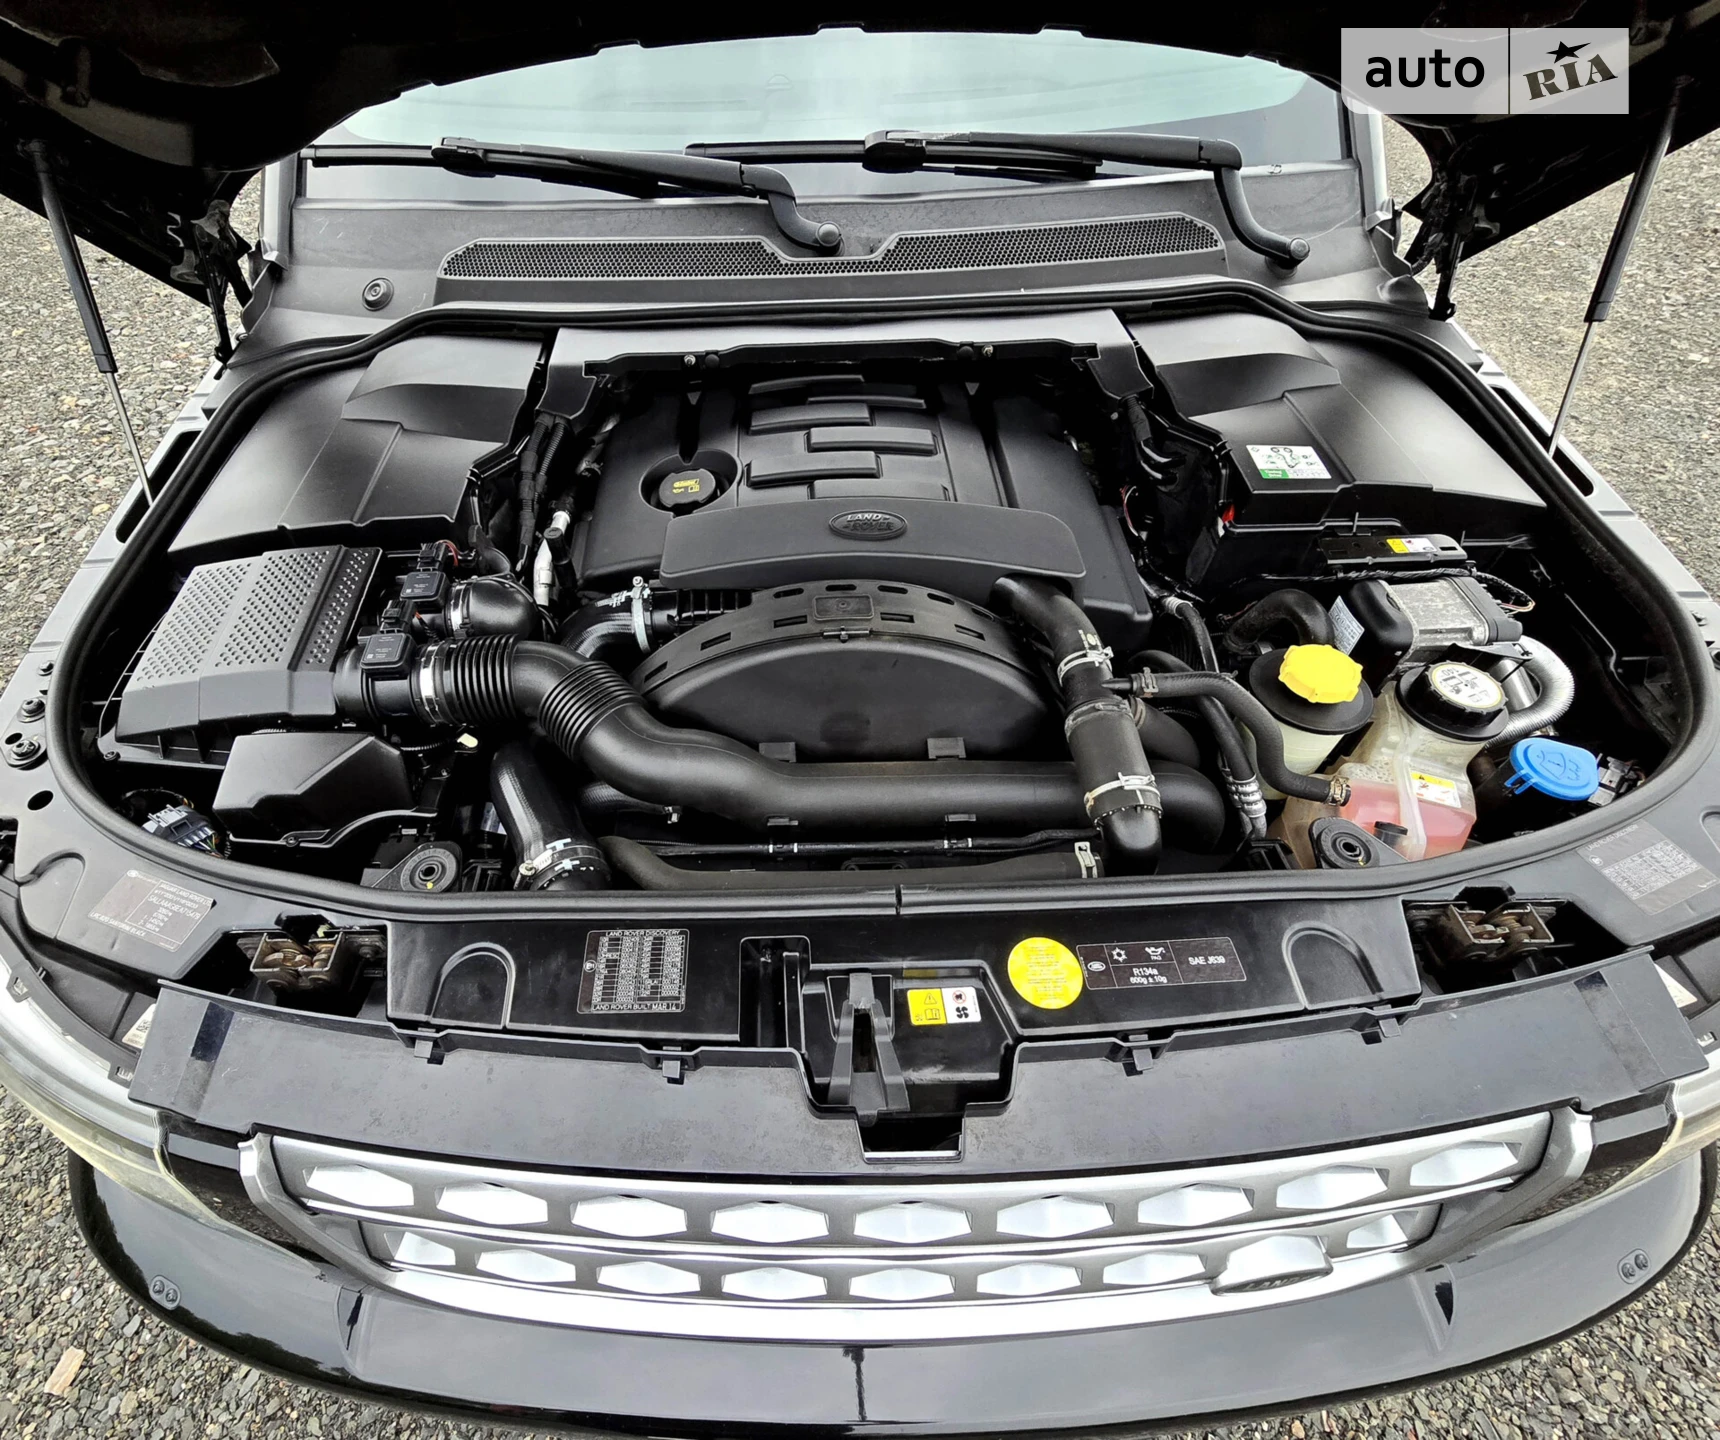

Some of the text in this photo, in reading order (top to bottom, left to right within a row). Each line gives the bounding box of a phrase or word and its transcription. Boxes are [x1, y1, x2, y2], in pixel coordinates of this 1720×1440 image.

[846, 512, 882, 522] LAND
[851, 521, 894, 531] ROVER
[175, 888, 190, 897] LAND
[188, 893, 204, 902] ROVER
[1188, 957, 1206, 965] SAE
[1132, 967, 1159, 977] R134a
[1154, 975, 1168, 984] 10g
[1243, 1277, 1298, 1291] LAND
